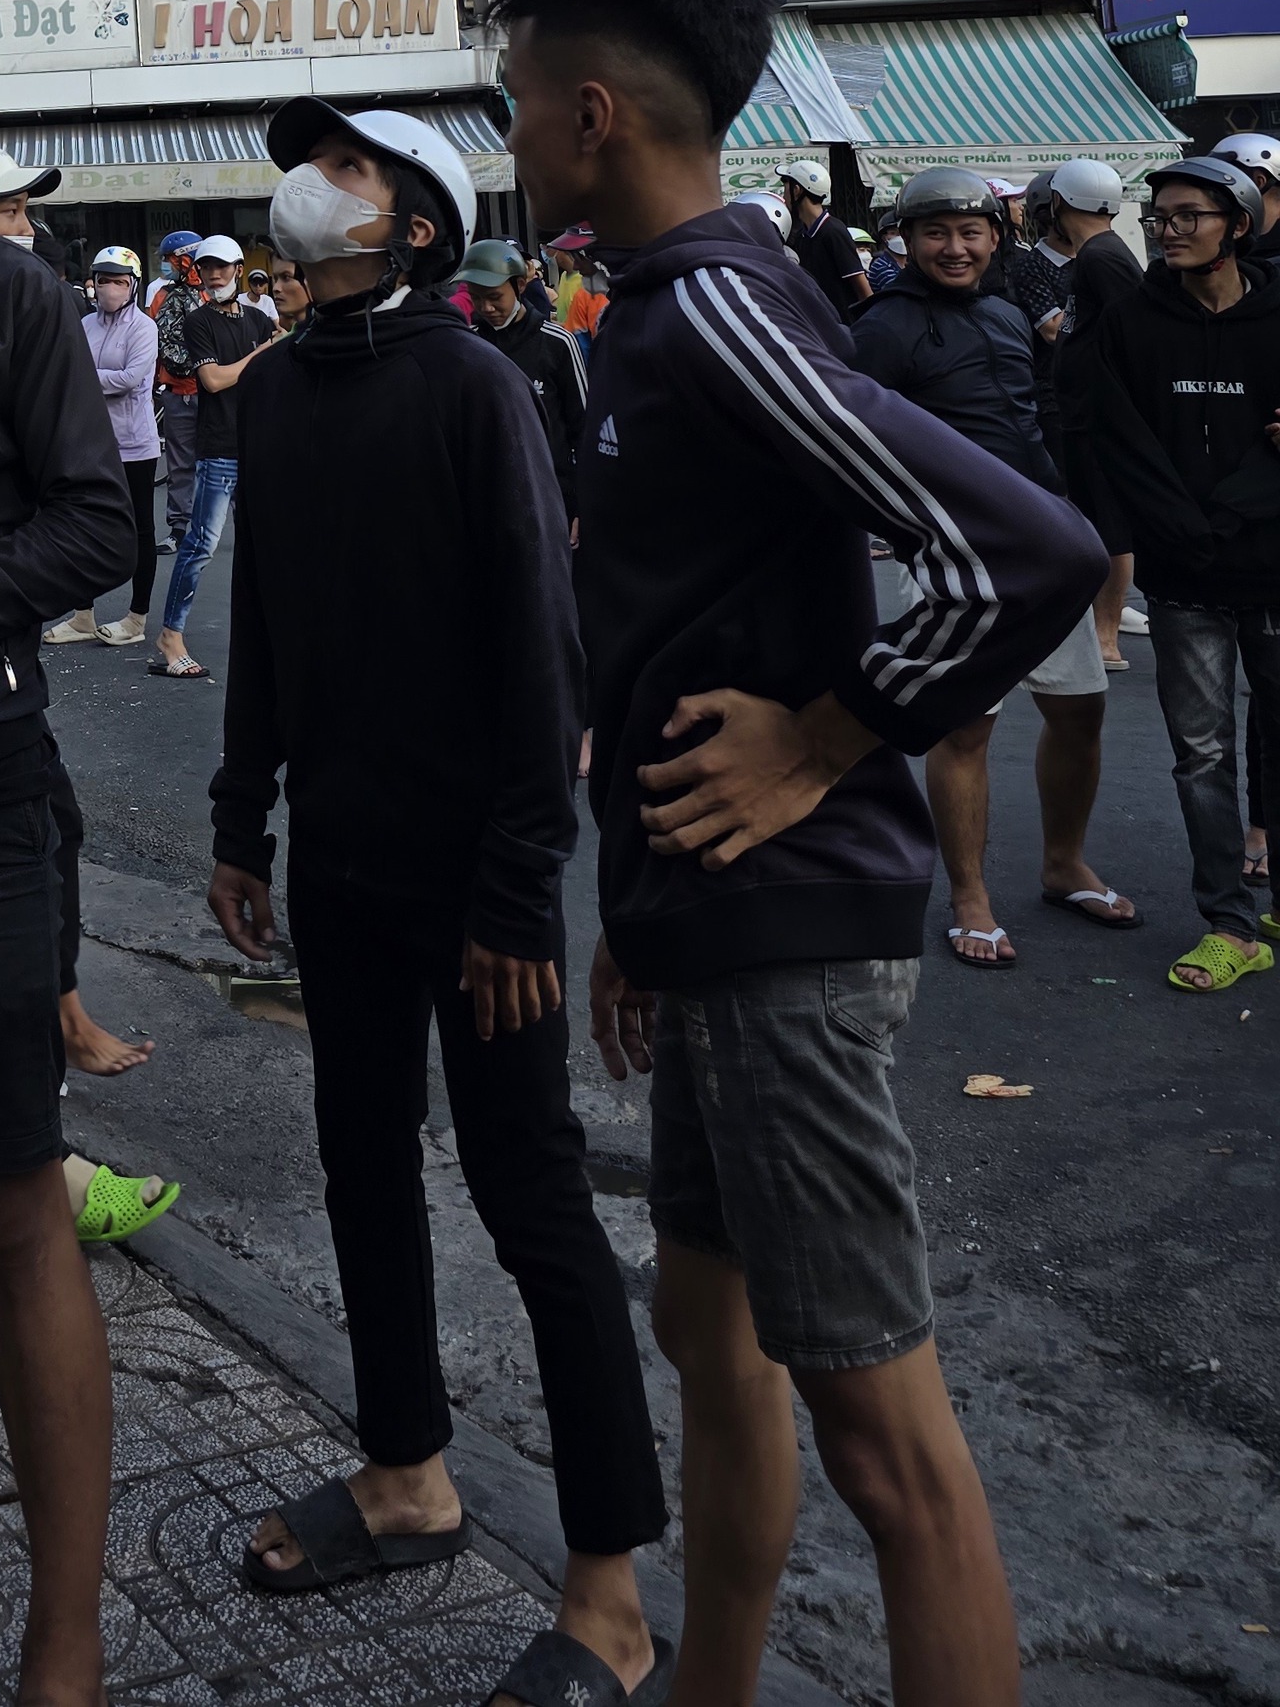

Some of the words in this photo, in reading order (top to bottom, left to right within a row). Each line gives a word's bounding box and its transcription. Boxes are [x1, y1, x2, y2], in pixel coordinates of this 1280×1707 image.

[750, 156, 780, 166] HỌC
[904, 153, 959, 164] PHÒNG
[964, 151, 1011, 163] PHẨM
[1105, 152, 1139, 162] HỌC
[1143, 152, 1180, 160] SINH
[70, 170, 150, 191] Đạt
